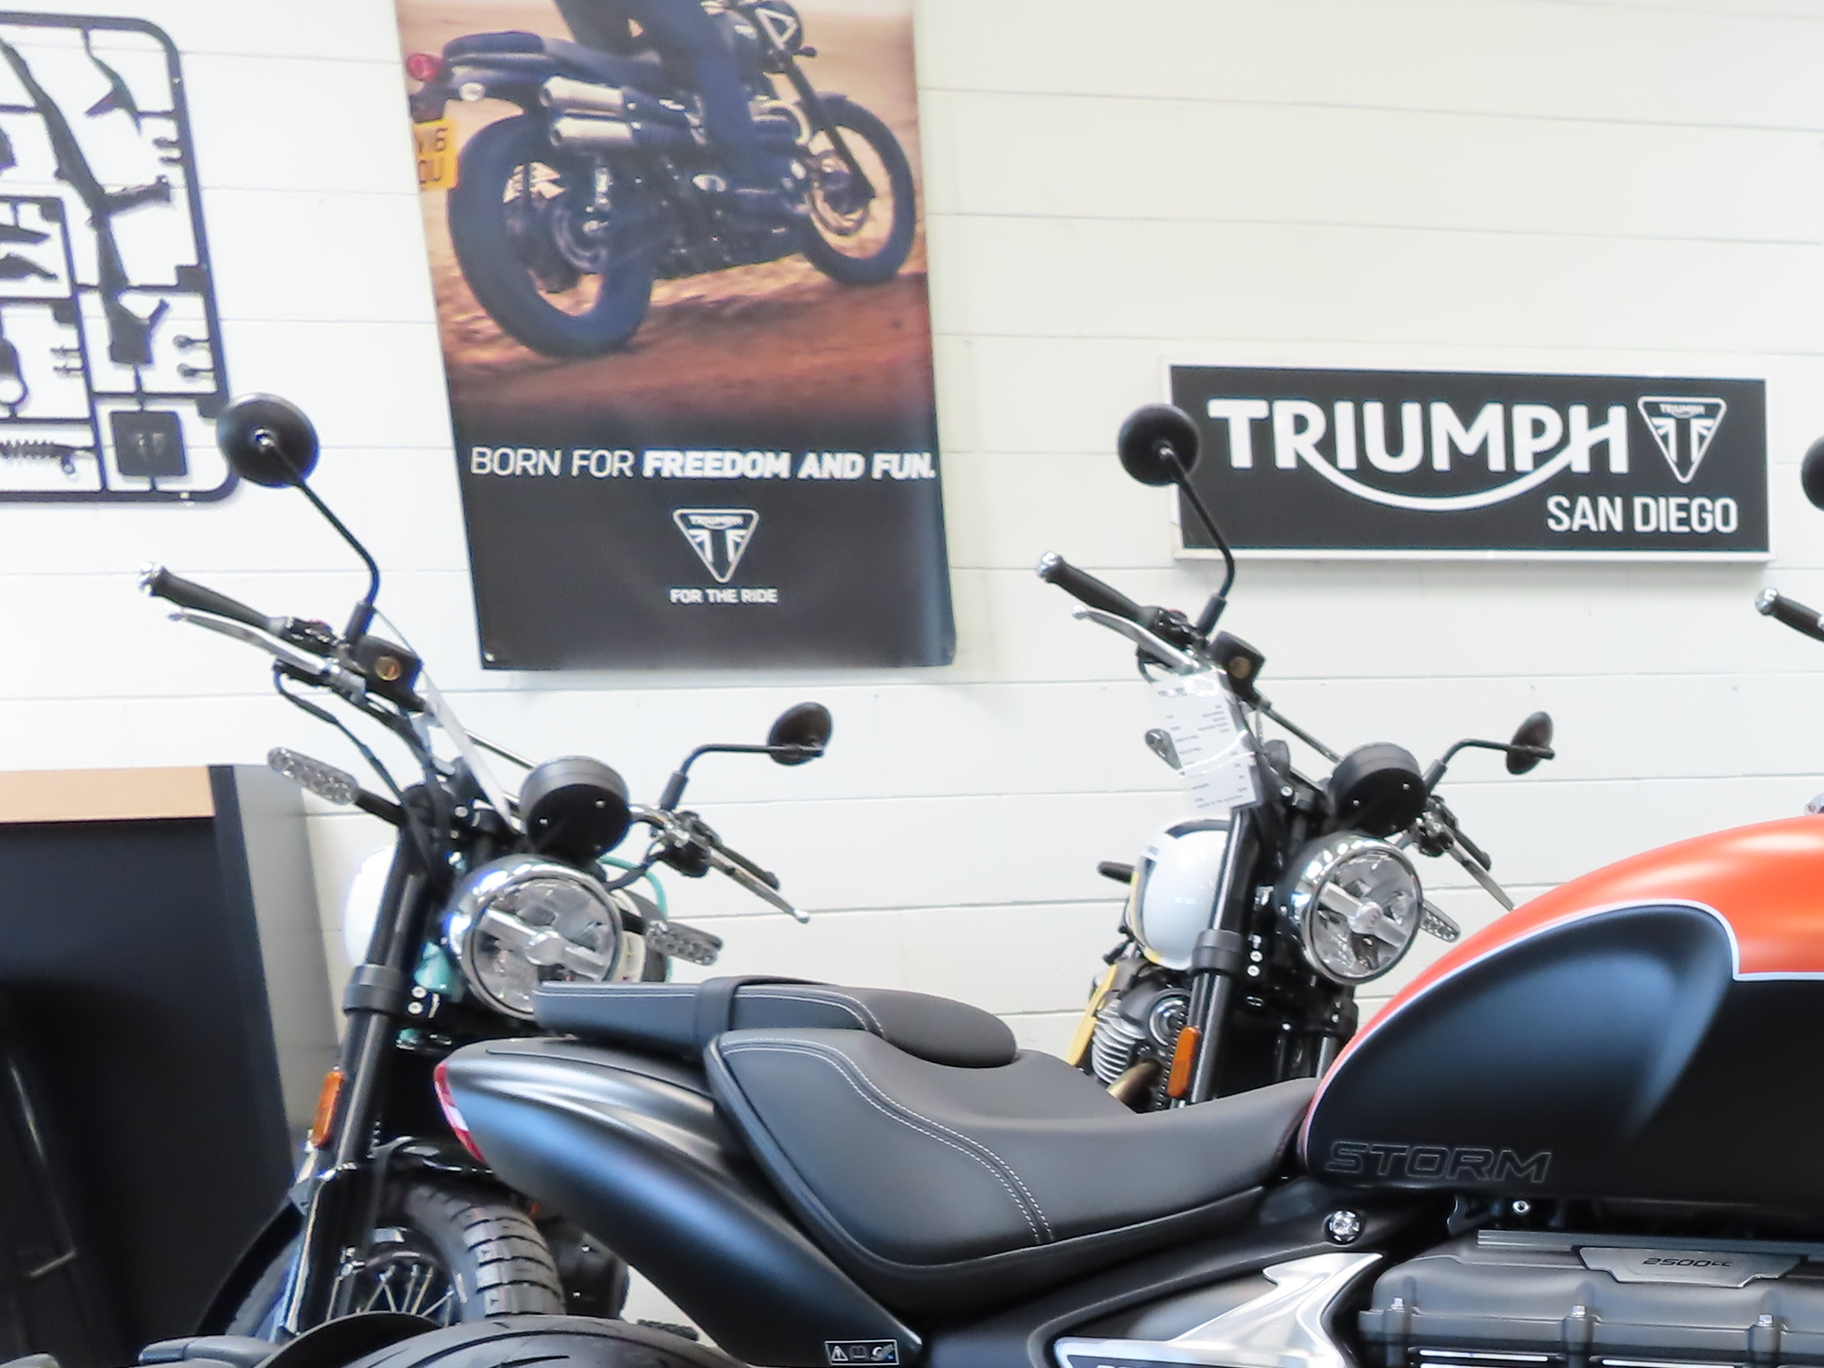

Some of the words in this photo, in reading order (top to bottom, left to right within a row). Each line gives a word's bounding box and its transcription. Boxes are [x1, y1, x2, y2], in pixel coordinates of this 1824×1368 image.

[470, 447, 562, 476] BORN
[571, 449, 635, 478] FOR
[642, 450, 791, 479] FREEDOM
[797, 452, 864, 479] AND
[870, 453, 936, 480] FUN.
[1208, 399, 1629, 512] TRIUMPH
[1547, 495, 1623, 532] SAN
[1633, 496, 1738, 533] DIEGO
[670, 588, 704, 604] FOR
[705, 588, 739, 603] THE
[741, 588, 779, 603] RIDE
[1325, 1141, 1551, 1183] STORM
